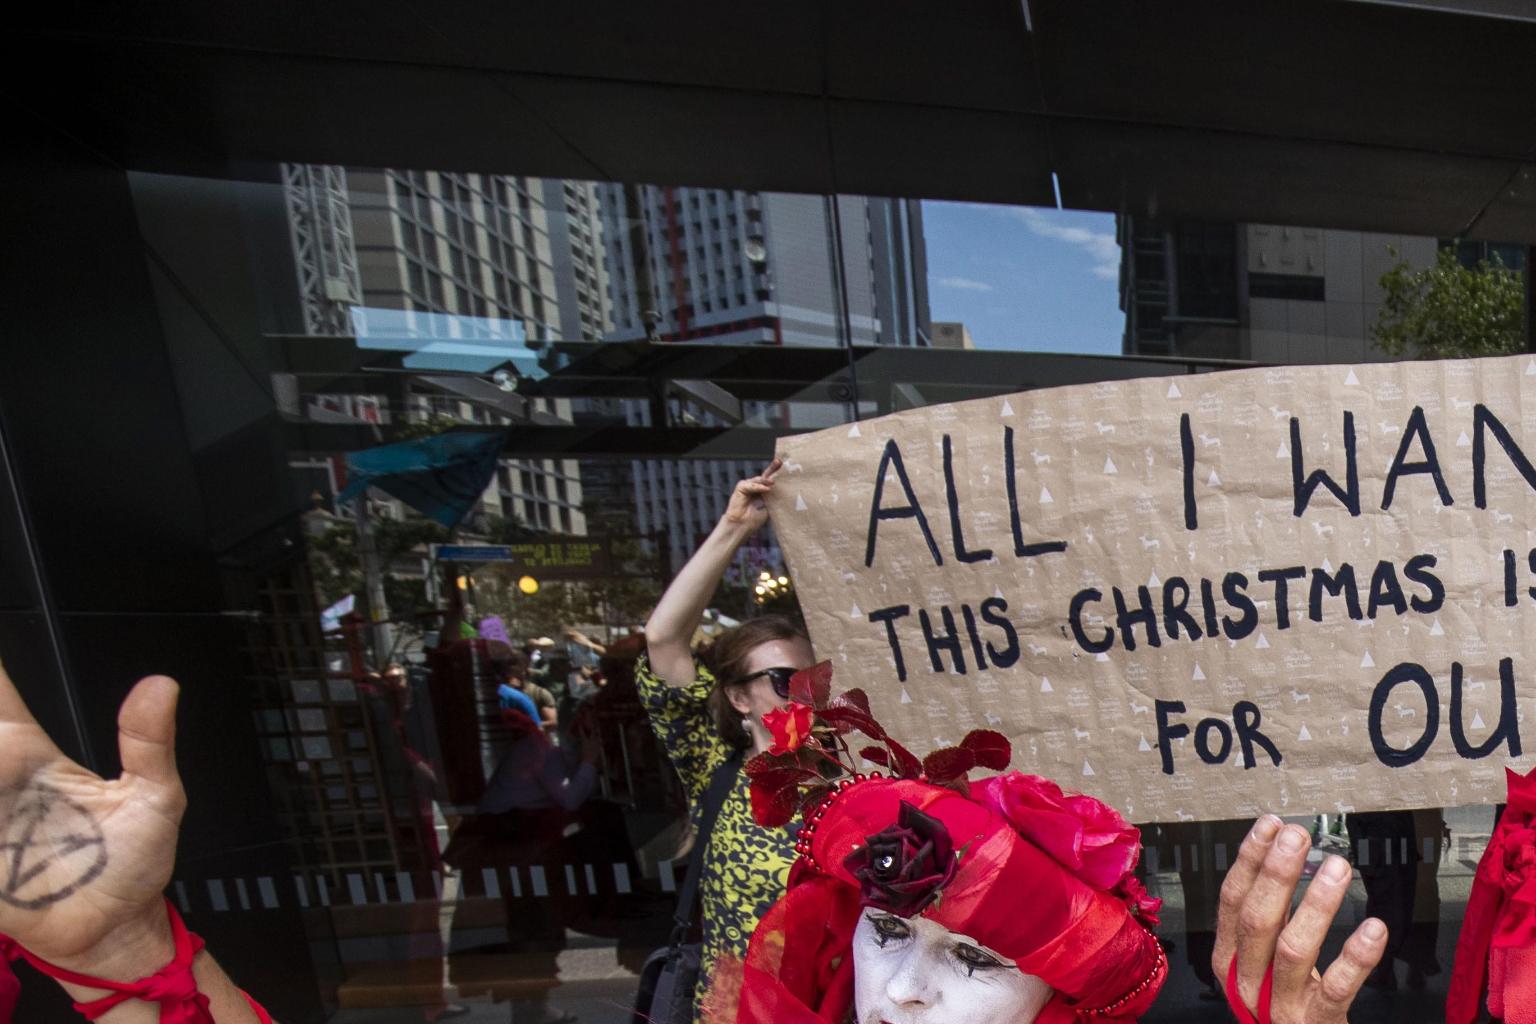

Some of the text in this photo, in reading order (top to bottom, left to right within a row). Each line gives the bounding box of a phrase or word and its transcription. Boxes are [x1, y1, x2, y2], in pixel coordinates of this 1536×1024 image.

[864, 425, 1068, 568] ALL
[1179, 412, 1199, 531] I
[868, 597, 1022, 683] THIS
[1067, 553, 1447, 655] CHRISTMAS
[1154, 699, 1283, 776] FOR
